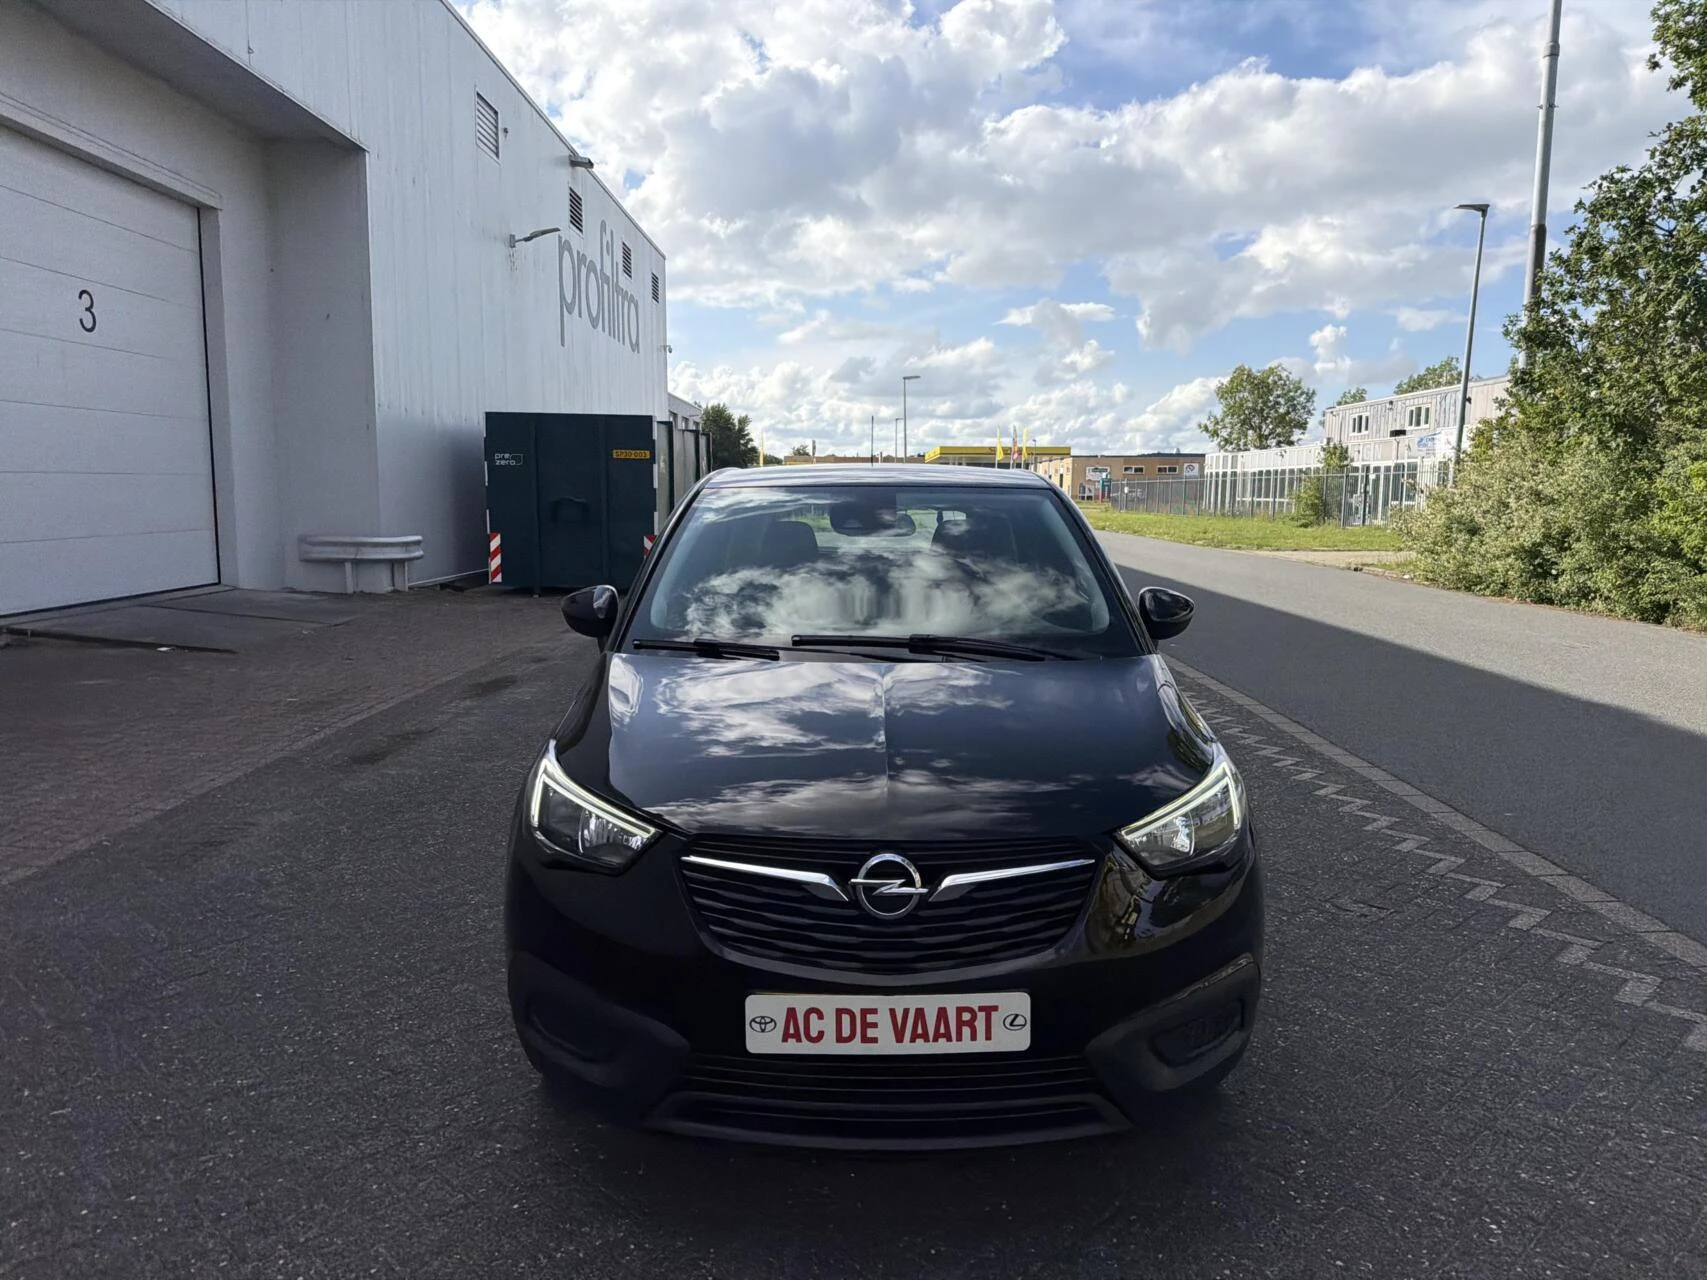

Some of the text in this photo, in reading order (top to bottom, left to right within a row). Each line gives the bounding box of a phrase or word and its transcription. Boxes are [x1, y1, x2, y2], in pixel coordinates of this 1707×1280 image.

[558, 219, 640, 354] profiltra
[78, 289, 97, 333] 3
[781, 1005, 999, 1044] AC DE VAART
